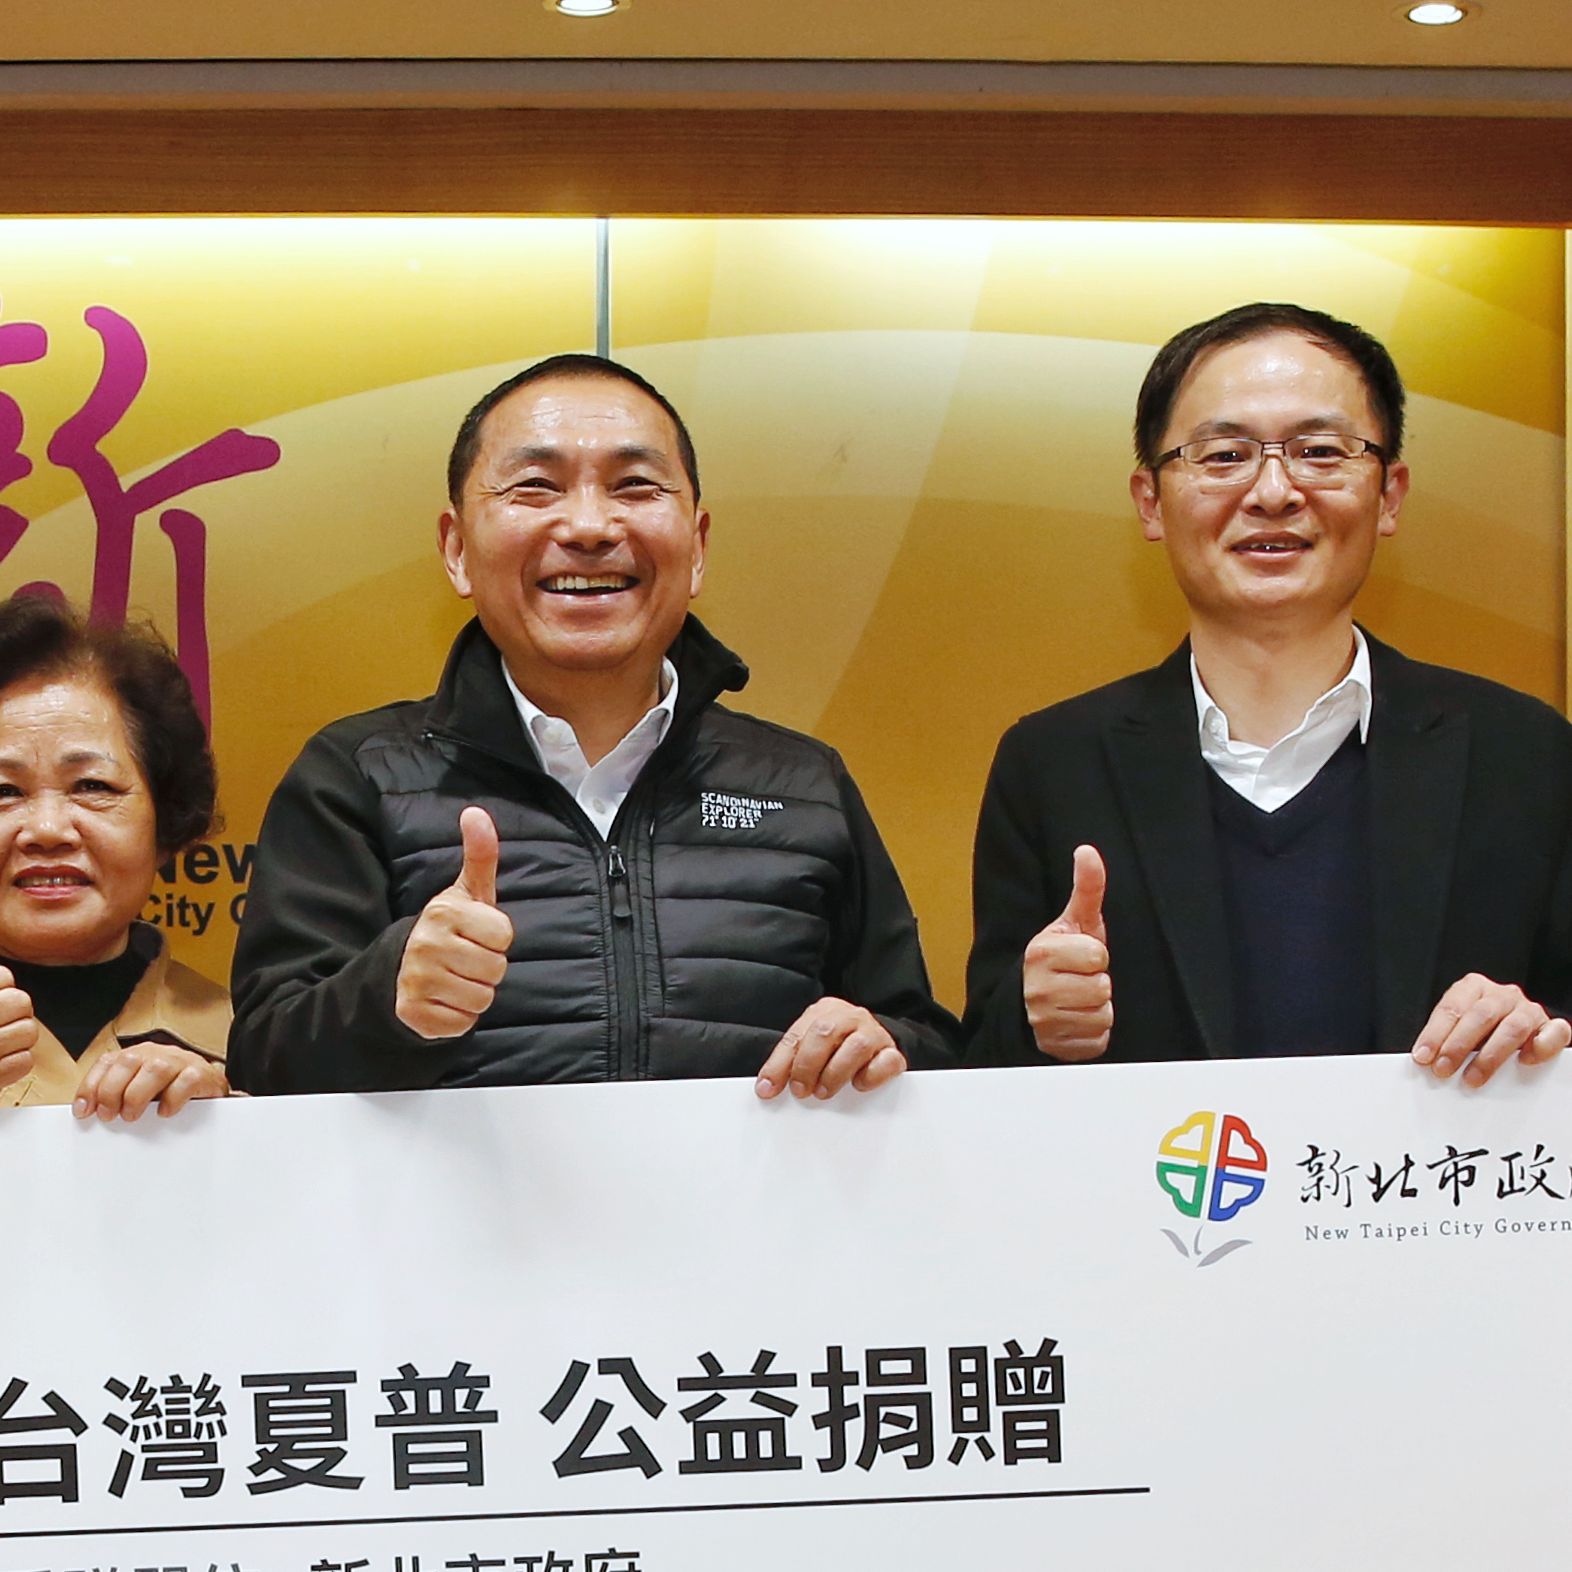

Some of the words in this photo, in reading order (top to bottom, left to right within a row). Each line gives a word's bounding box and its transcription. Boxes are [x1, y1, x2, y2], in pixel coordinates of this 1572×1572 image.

[701, 793, 784, 810] SCANDINAVIAN
[701, 803, 763, 819] EXPLORER
[135, 893, 215, 936] City
[1305, 1225, 1349, 1241] New
[1360, 1222, 1428, 1242] Taipei
[1440, 1220, 1483, 1239] City
[539, 1338, 1067, 1483] 公益捐贈
